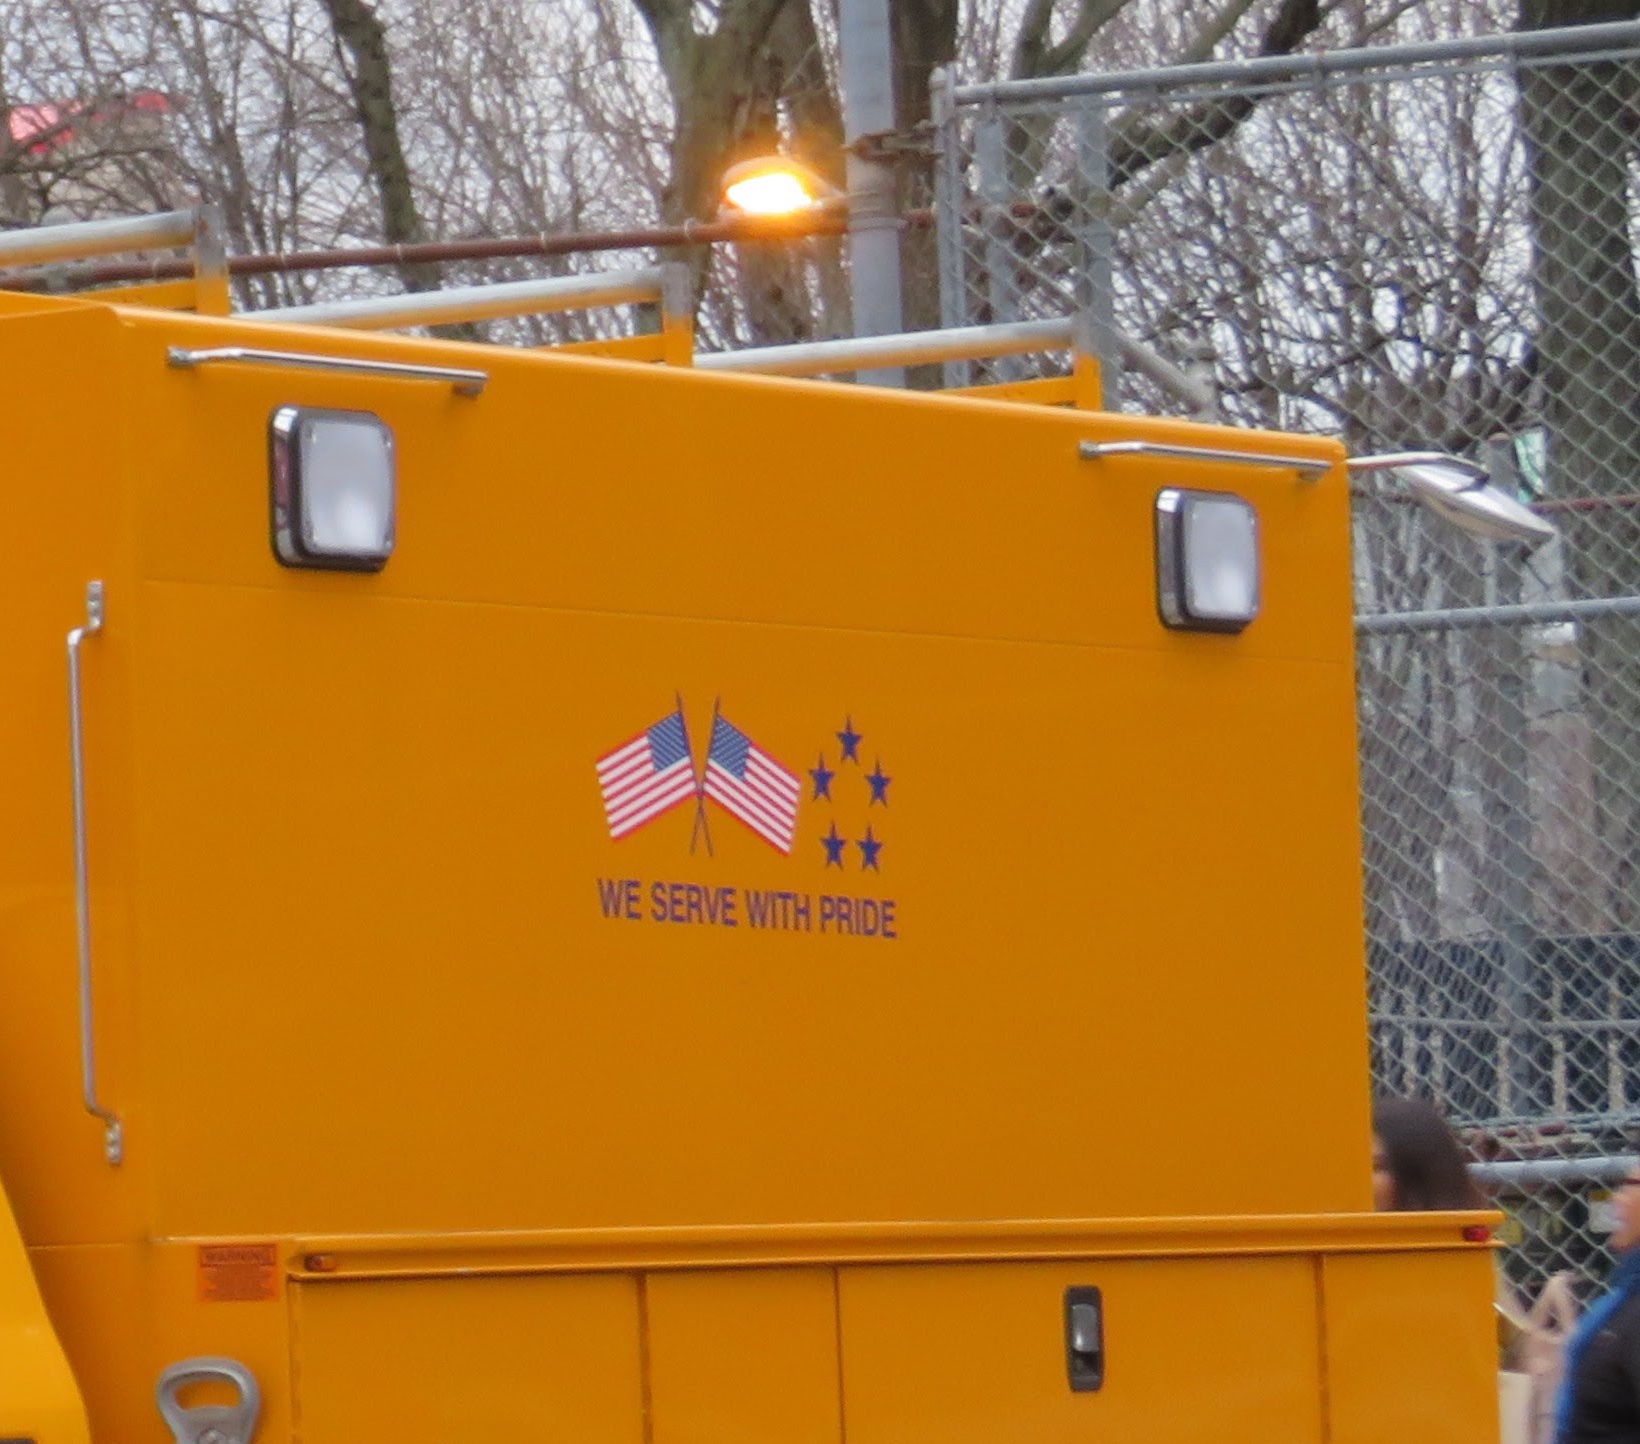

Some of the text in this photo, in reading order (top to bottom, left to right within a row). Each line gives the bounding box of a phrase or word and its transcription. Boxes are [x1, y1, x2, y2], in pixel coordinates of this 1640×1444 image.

[597, 878, 898, 940] WE SERVE WITH PRIDE
